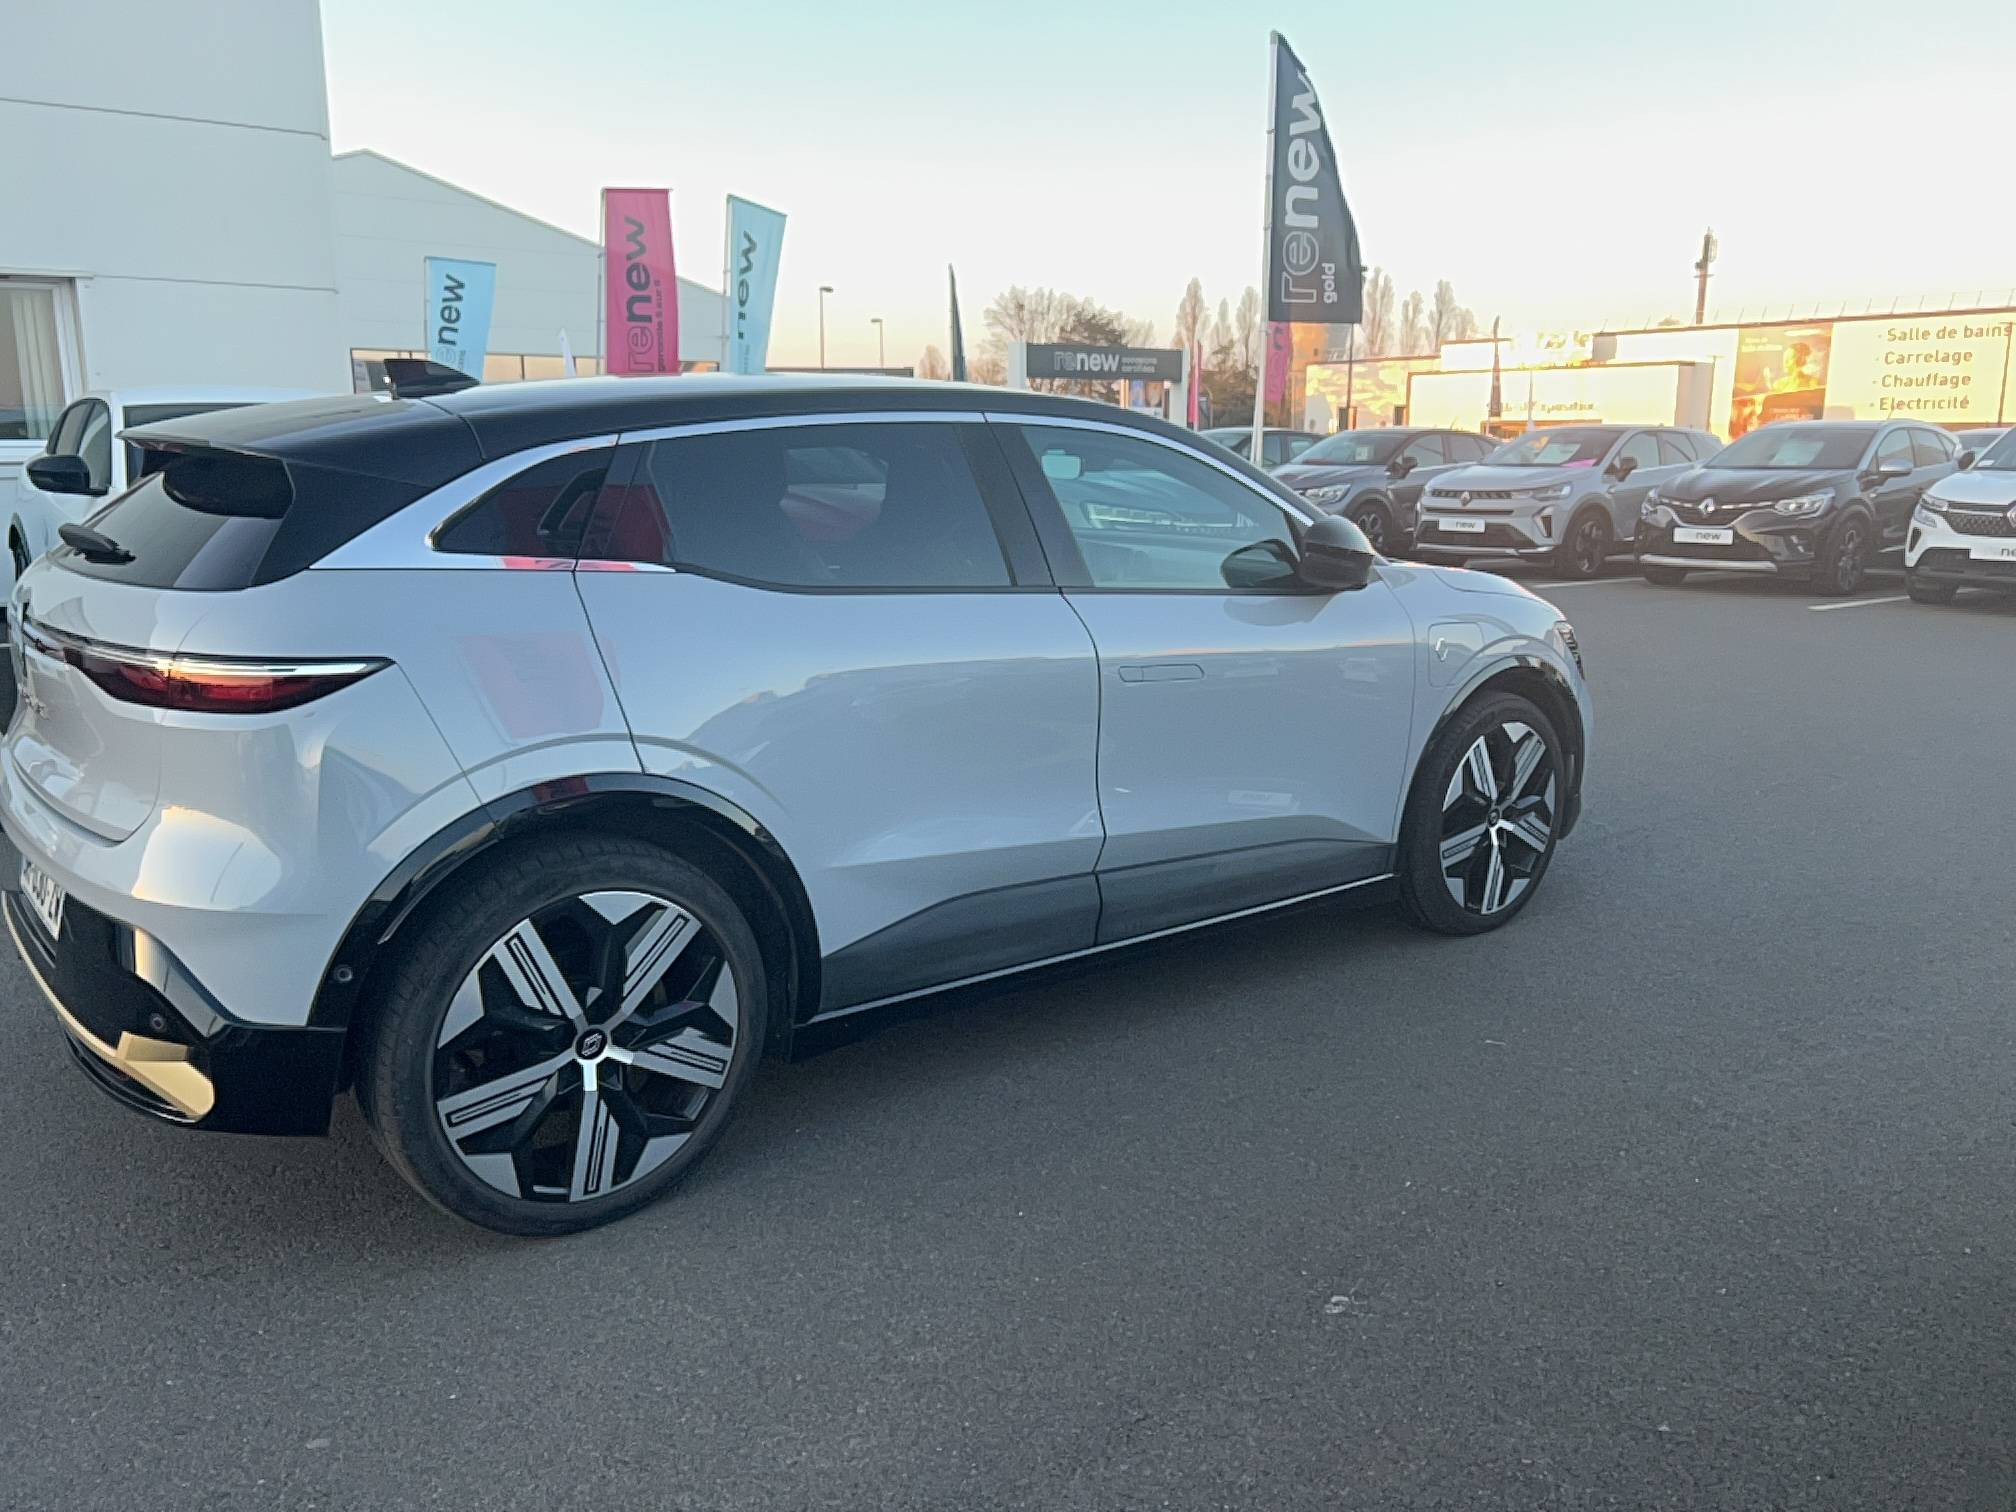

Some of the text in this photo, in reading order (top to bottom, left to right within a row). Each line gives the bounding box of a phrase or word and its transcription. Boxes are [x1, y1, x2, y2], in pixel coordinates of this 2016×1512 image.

[1281, 69, 1321, 303] renew
[1322, 262, 1338, 304] gold
[624, 215, 654, 372] renew
[1887, 324, 2013, 341] Salle de bains
[1053, 350, 1120, 372] renew
[1884, 349, 1973, 365] Carrelage
[1881, 372, 1972, 389] Chauffage
[1879, 394, 1970, 411] Electricité
[1455, 520, 1476, 528] new
[1695, 531, 1722, 540] new
